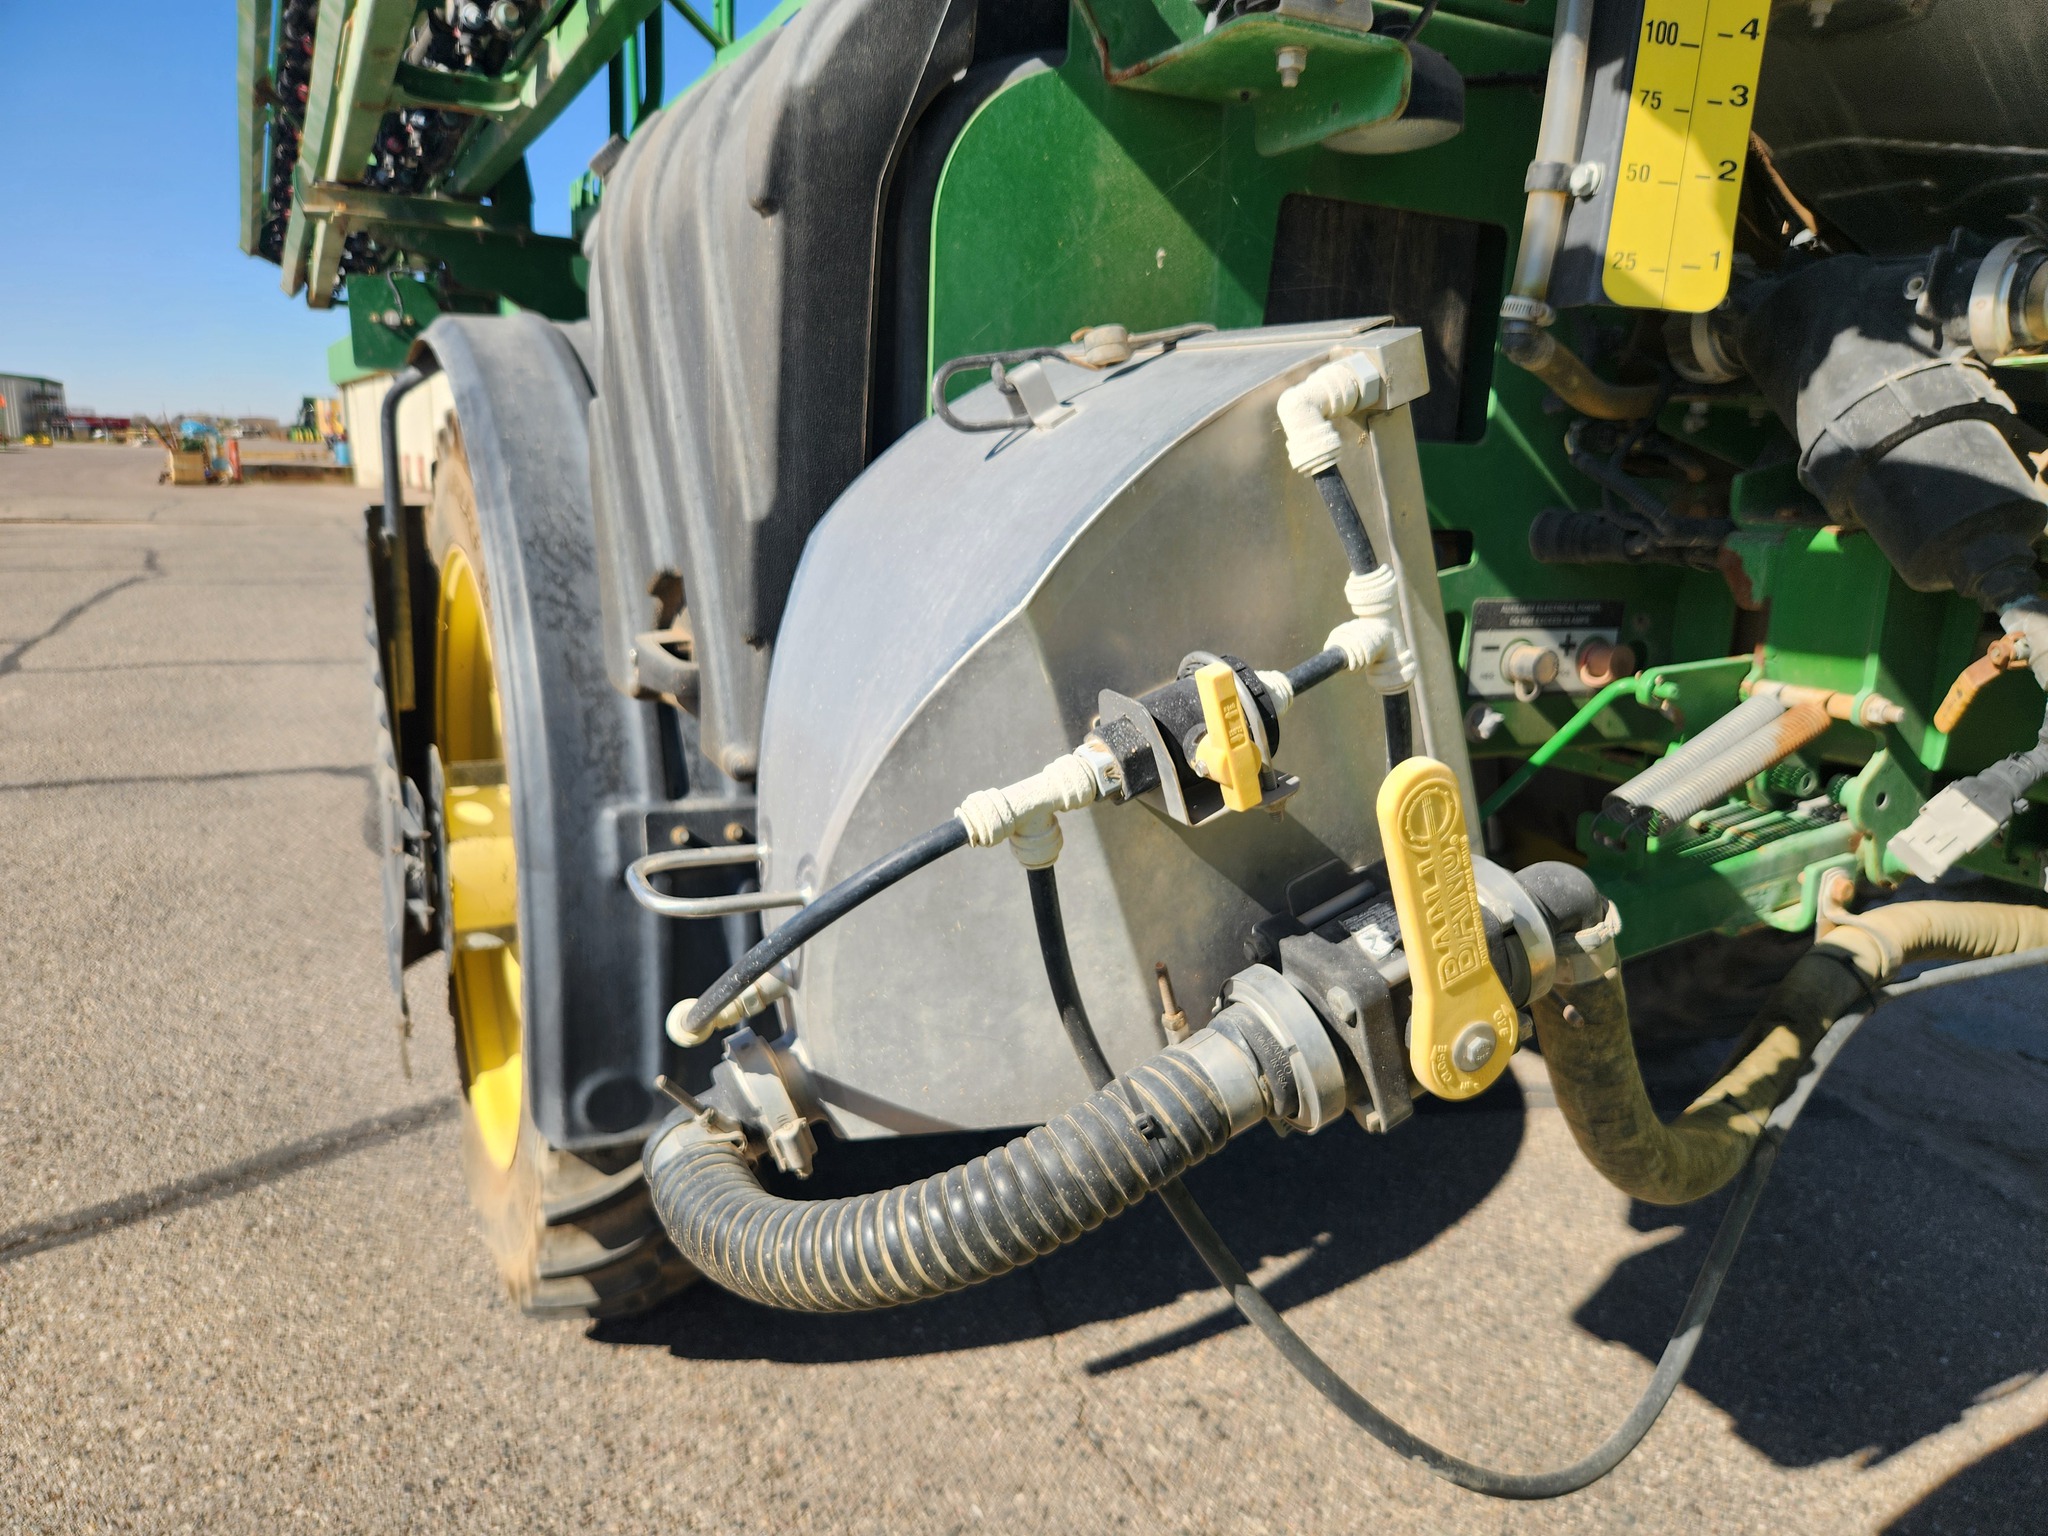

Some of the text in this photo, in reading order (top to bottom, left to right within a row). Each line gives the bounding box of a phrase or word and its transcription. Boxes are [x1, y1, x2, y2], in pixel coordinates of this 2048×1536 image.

[1646, 19, 1679, 46] 100
[1740, 18, 1760, 40] 4
[1640, 89, 1663, 110] 75
[1729, 84, 1749, 107] 3
[1626, 163, 1650, 183] 50
[1718, 160, 1737, 182] 2
[1612, 252, 1637, 271] 25
[1711, 251, 1721, 271] 1
[1267, 1036, 1293, 1075] BANJO
